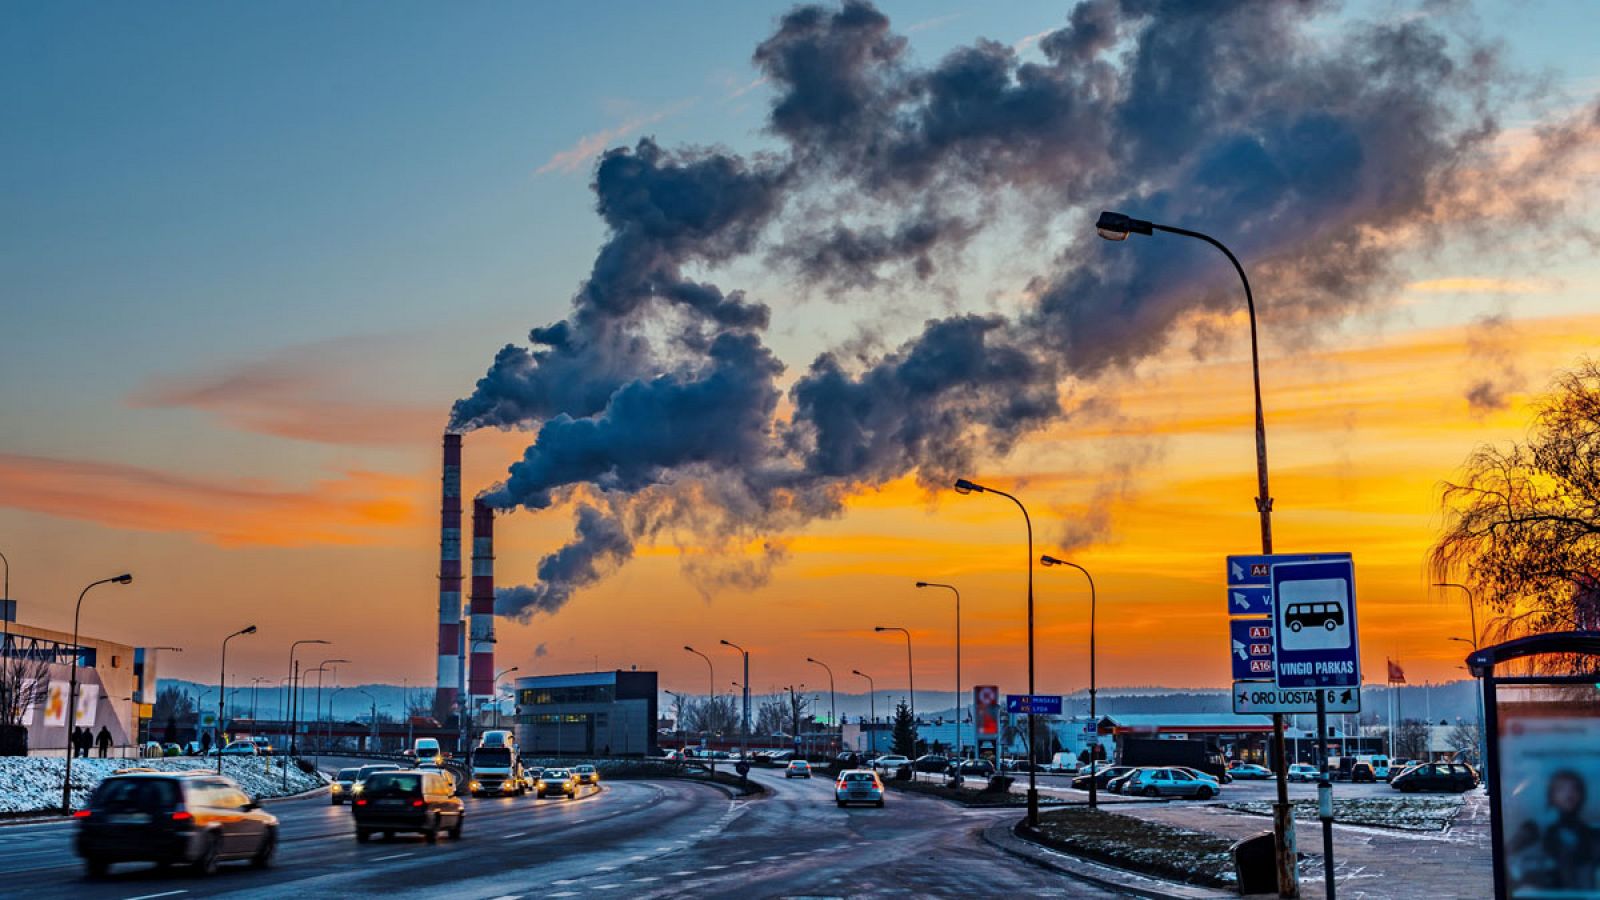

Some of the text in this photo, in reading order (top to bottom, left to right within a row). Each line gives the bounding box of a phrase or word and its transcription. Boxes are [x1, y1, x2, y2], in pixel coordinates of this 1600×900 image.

[1252, 566, 1268, 576] A4
[1253, 628, 1267, 637] A1
[1253, 645, 1268, 654] A4
[1252, 662, 1270, 671] A16
[1280, 660, 1354, 676] VINGIO PARKAS
[1251, 690, 1336, 704] ORO UOSTA 6
